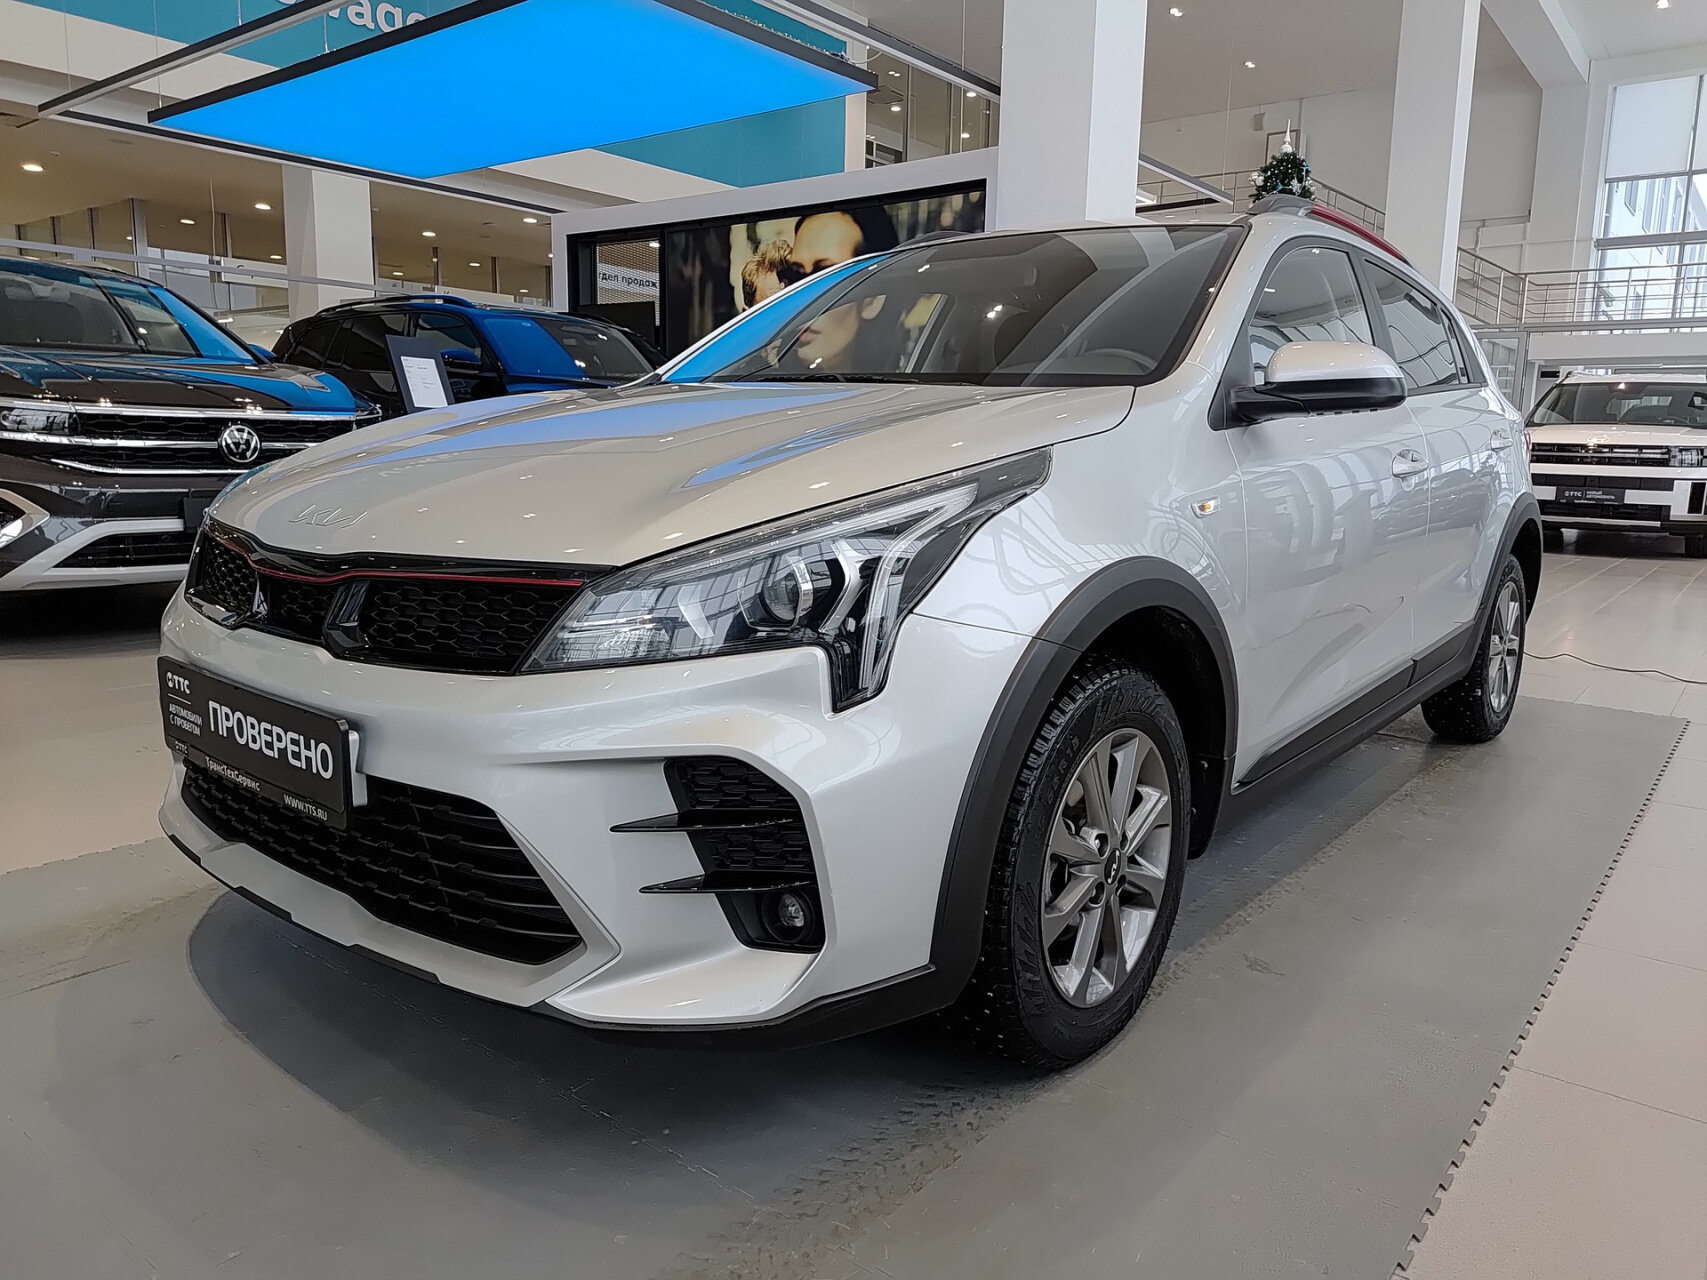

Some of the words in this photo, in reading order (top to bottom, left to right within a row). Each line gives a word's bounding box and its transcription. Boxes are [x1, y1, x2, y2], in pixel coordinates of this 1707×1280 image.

[169, 703, 202, 727] АВТОМОБИЛИ
[174, 716, 201, 737] ПРОБЕГОМ
[208, 700, 334, 779] ПРОВЕРЕНО
[205, 756, 261, 792] ТрансТехСервис
[283, 794, 328, 821] WWW.TTS.RU
